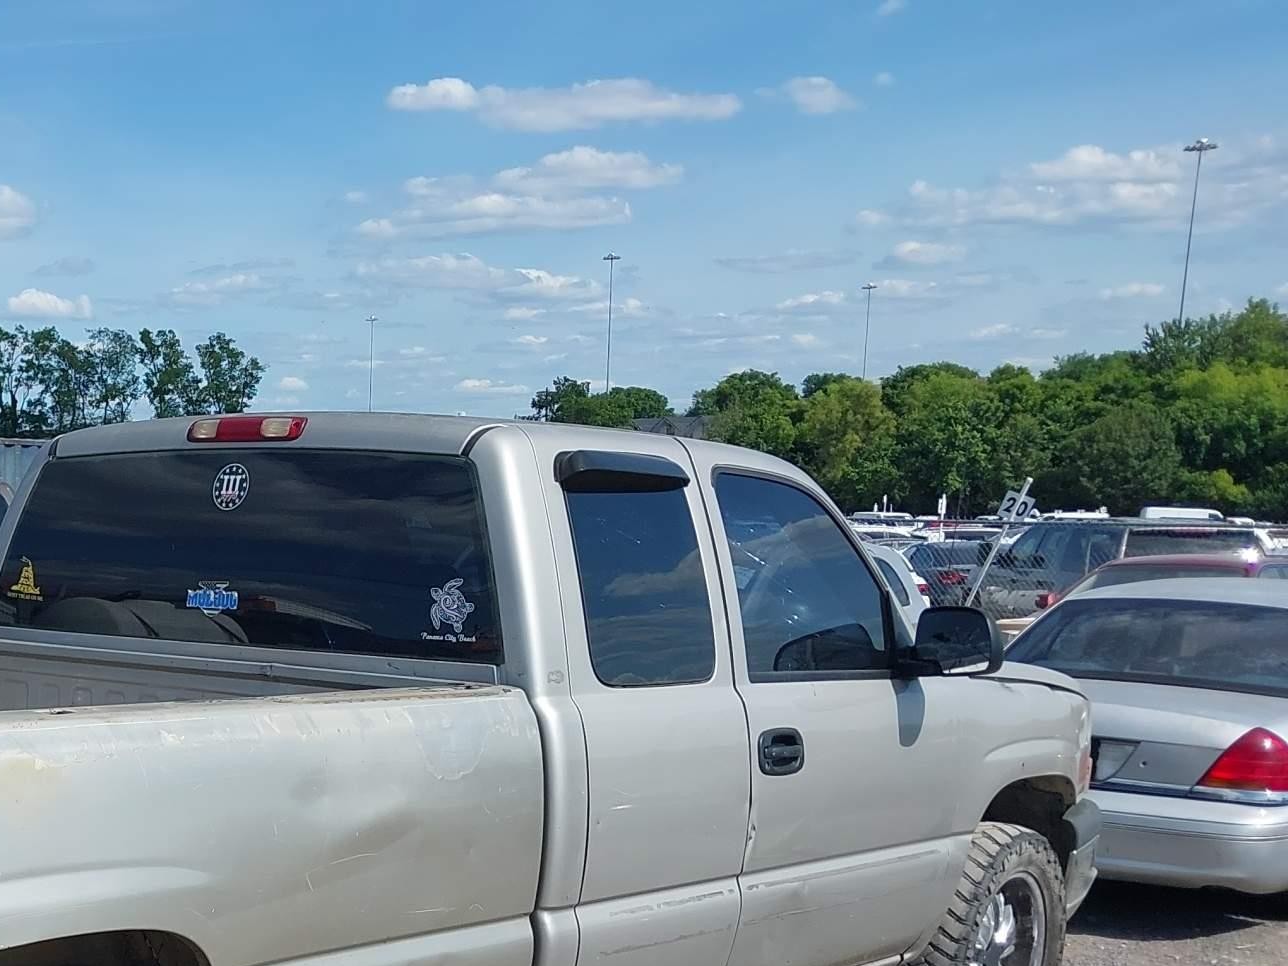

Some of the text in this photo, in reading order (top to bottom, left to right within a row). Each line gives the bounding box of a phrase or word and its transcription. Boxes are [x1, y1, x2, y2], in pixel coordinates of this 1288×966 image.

[1002, 497, 1028, 517] 20
[420, 632, 476, 643] Panama City Beach
